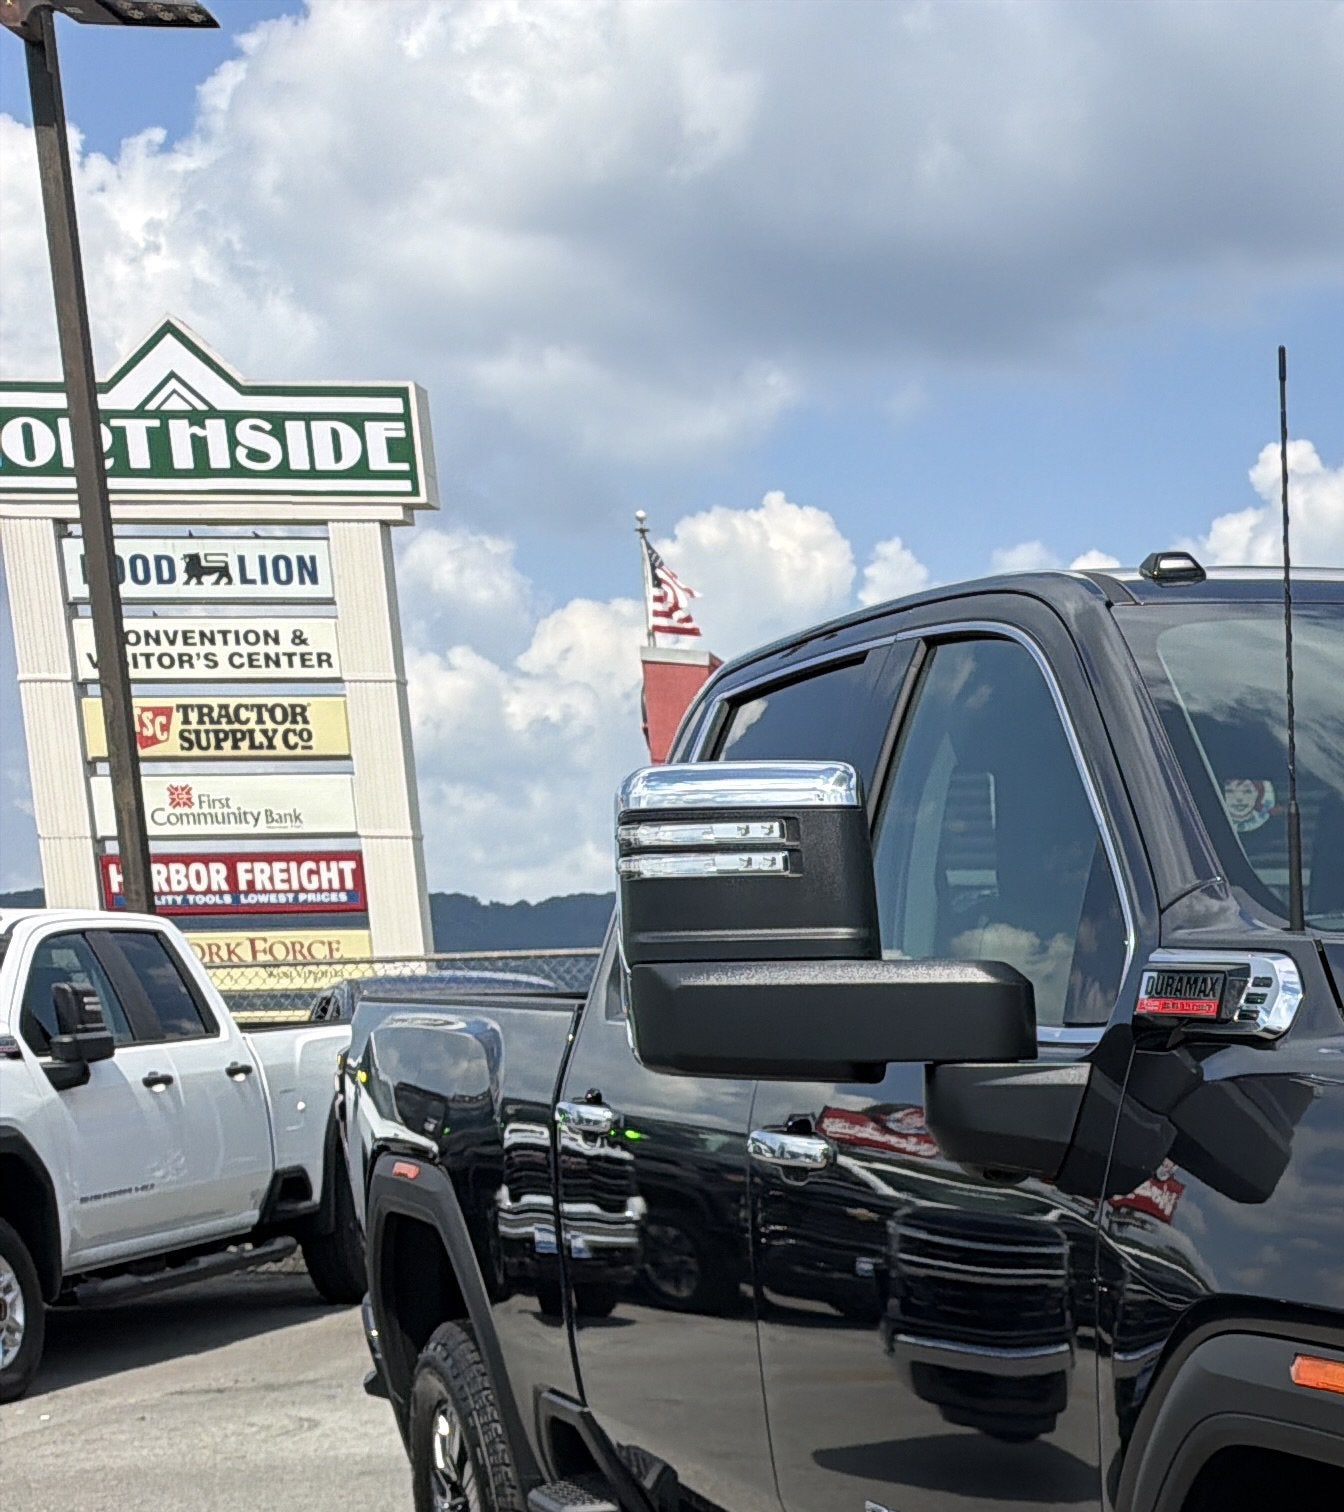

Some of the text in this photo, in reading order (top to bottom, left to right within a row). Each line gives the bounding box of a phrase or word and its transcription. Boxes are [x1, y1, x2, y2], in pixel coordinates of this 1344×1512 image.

[1, 416, 410, 471] OTHSIDE
[80, 553, 319, 586] OD LION
[124, 628, 310, 647] ONVENTION &
[87, 651, 334, 670] VITOR'S CENTER
[176, 702, 310, 726] TRACTOR
[178, 728, 278, 751] SUPPLY
[198, 794, 231, 810] First
[151, 807, 303, 827] Community Bank
[108, 860, 357, 893] HRBOR FREIGHT
[154, 891, 348, 906] LITY TOOLS LOWEST PRICES
[191, 936, 344, 963] ORK FORCE
[1144, 975, 1220, 999] DURAMAX
